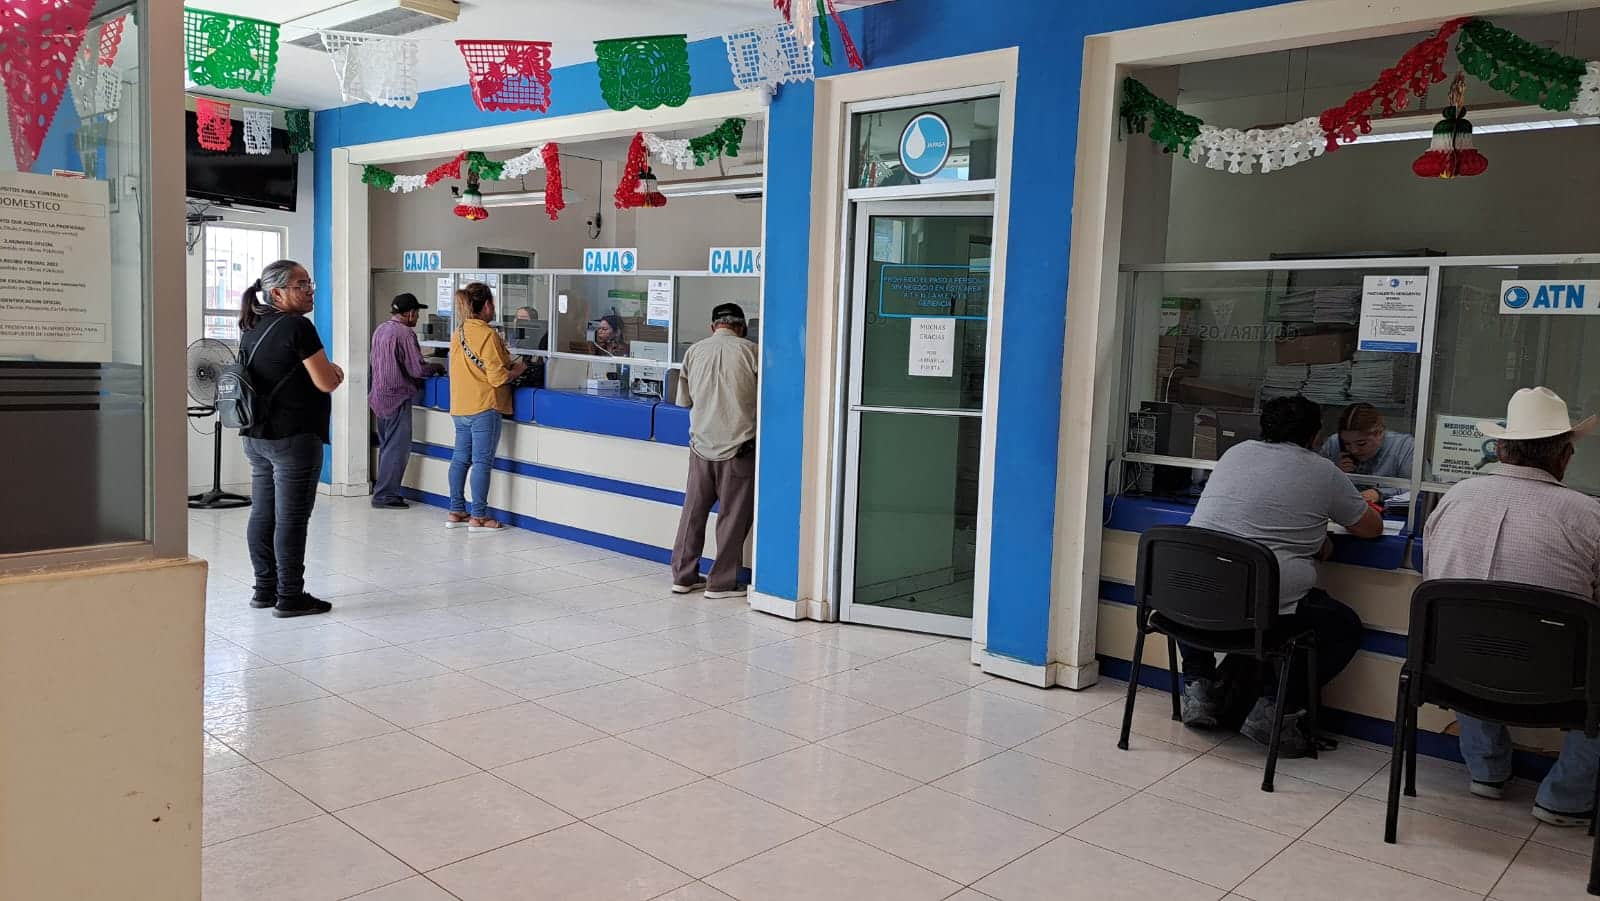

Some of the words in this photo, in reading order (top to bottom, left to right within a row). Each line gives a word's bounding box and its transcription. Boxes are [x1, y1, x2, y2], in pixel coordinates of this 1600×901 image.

[405, 252, 428, 271] CAJA
[585, 251, 619, 272] CAJA
[711, 250, 753, 274] CAJA
[1532, 284, 1585, 309] ATN
[920, 323, 946, 331] MUCHAS
[920, 333, 945, 341] GRACIAS
